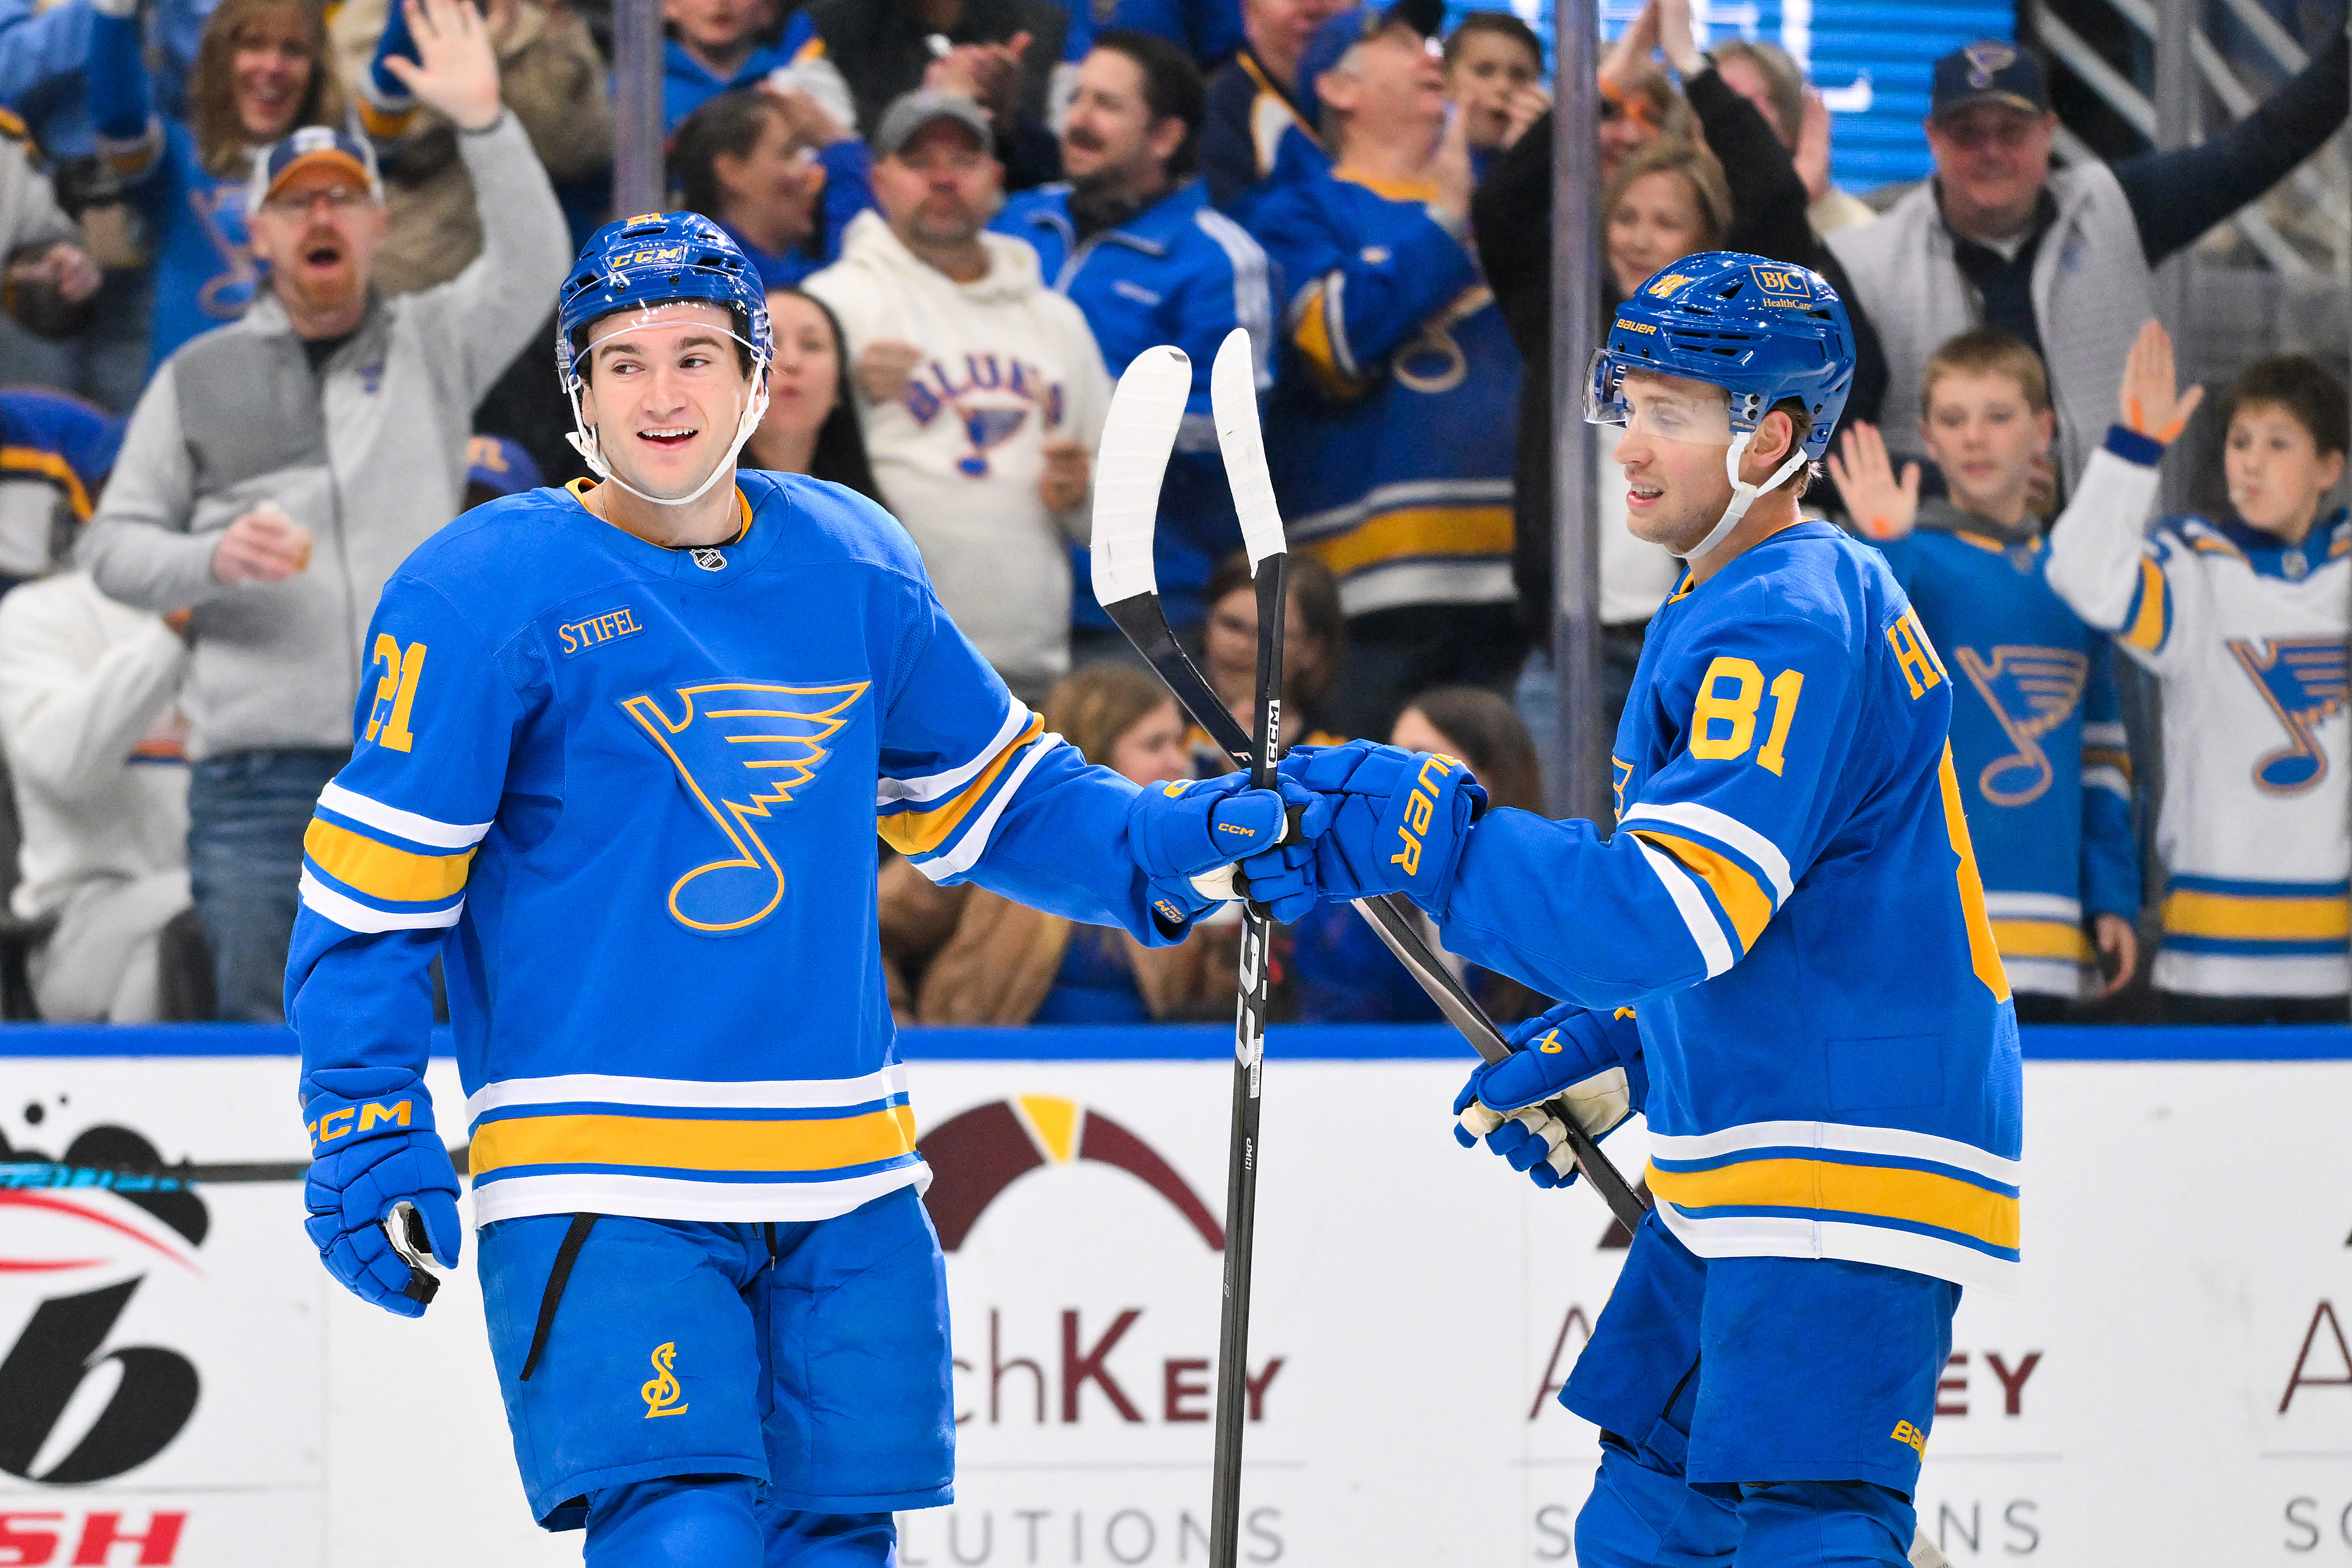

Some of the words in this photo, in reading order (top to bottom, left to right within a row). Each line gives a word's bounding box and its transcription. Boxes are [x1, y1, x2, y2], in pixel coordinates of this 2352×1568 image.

[613, 248, 680, 268] CCM
[1759, 271, 1802, 292] BJC
[1763, 297, 1812, 311] HealthCare
[1616, 318, 1657, 335] BAUER
[701, 552, 717, 567] NHL
[559, 609, 643, 654] STIFEL
[365, 633, 427, 753] 21
[1689, 656, 1804, 777] 81
[1268, 705, 1279, 764] CCM
[1218, 823, 1255, 837] CCM
[1154, 900, 1182, 923] CCM
